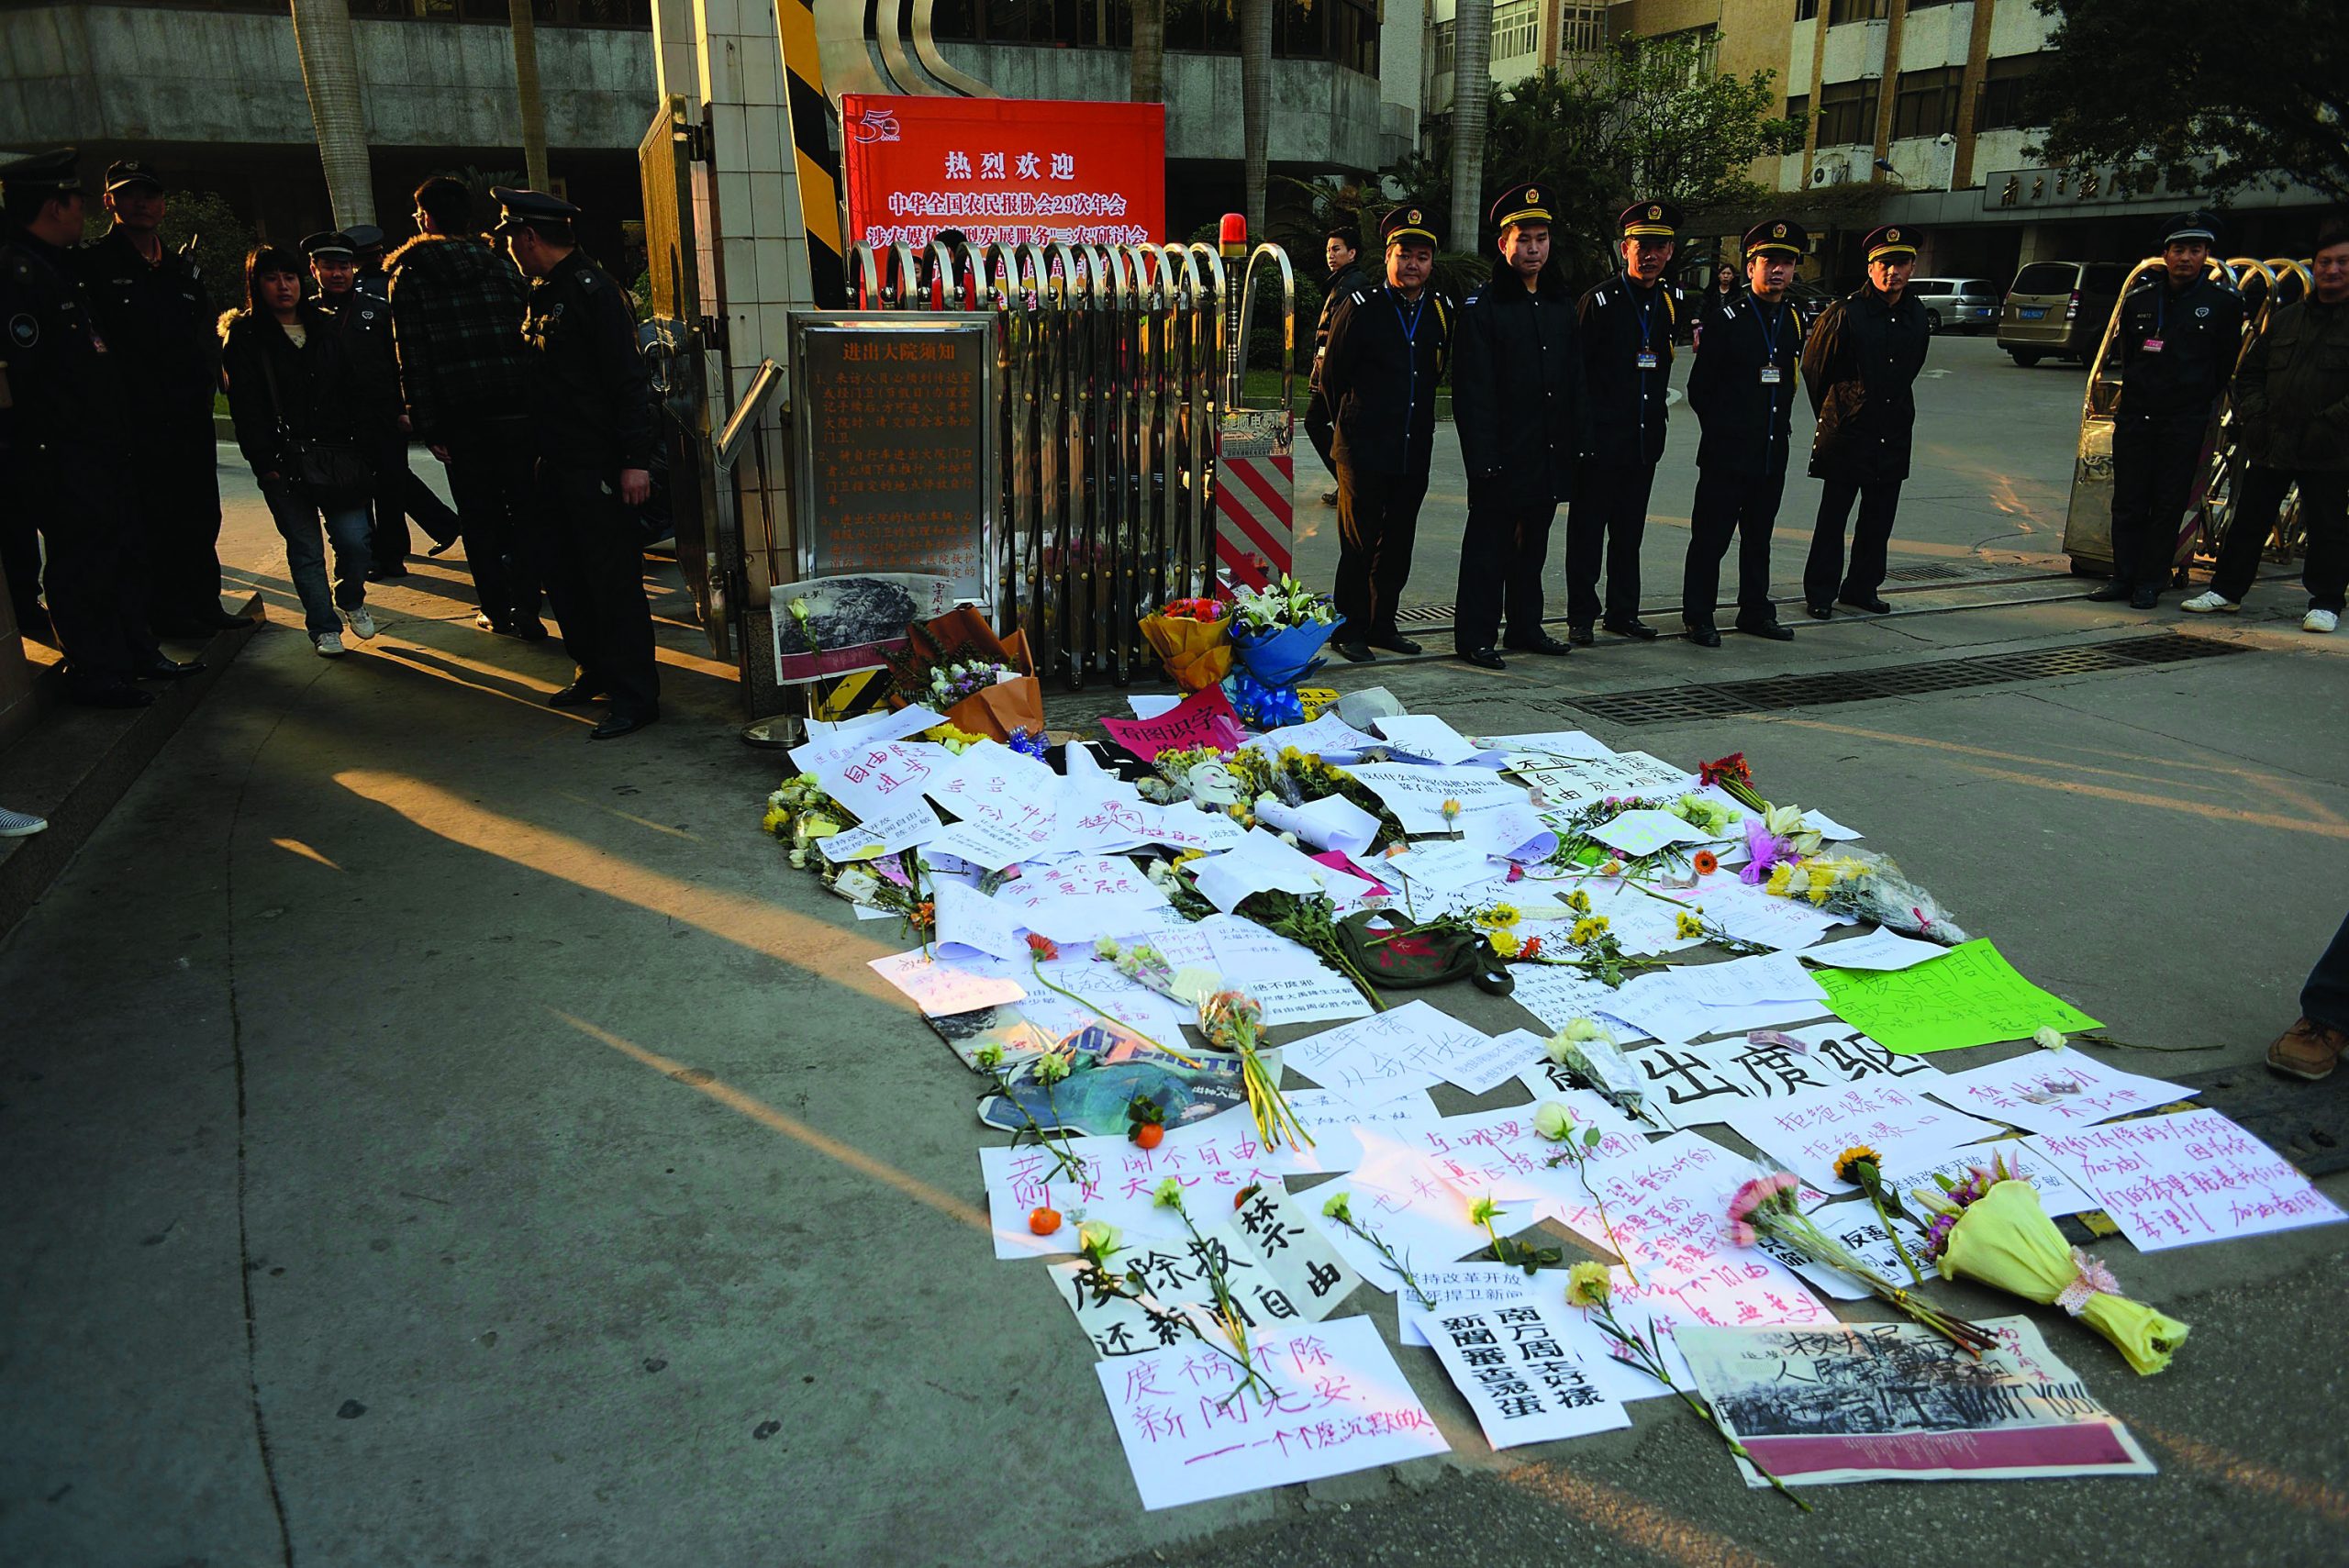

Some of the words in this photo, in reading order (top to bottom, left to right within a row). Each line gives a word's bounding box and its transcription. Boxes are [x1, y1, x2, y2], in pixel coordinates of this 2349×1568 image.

[944, 150, 1075, 181] 热烈欢迎
[888, 192, 1127, 217] 中华全国农民报协会29次年会
[866, 226, 1148, 250] 涉农媒体型发展服务"三农"研讨会
[843, 342, 955, 361] 进出大院须知
